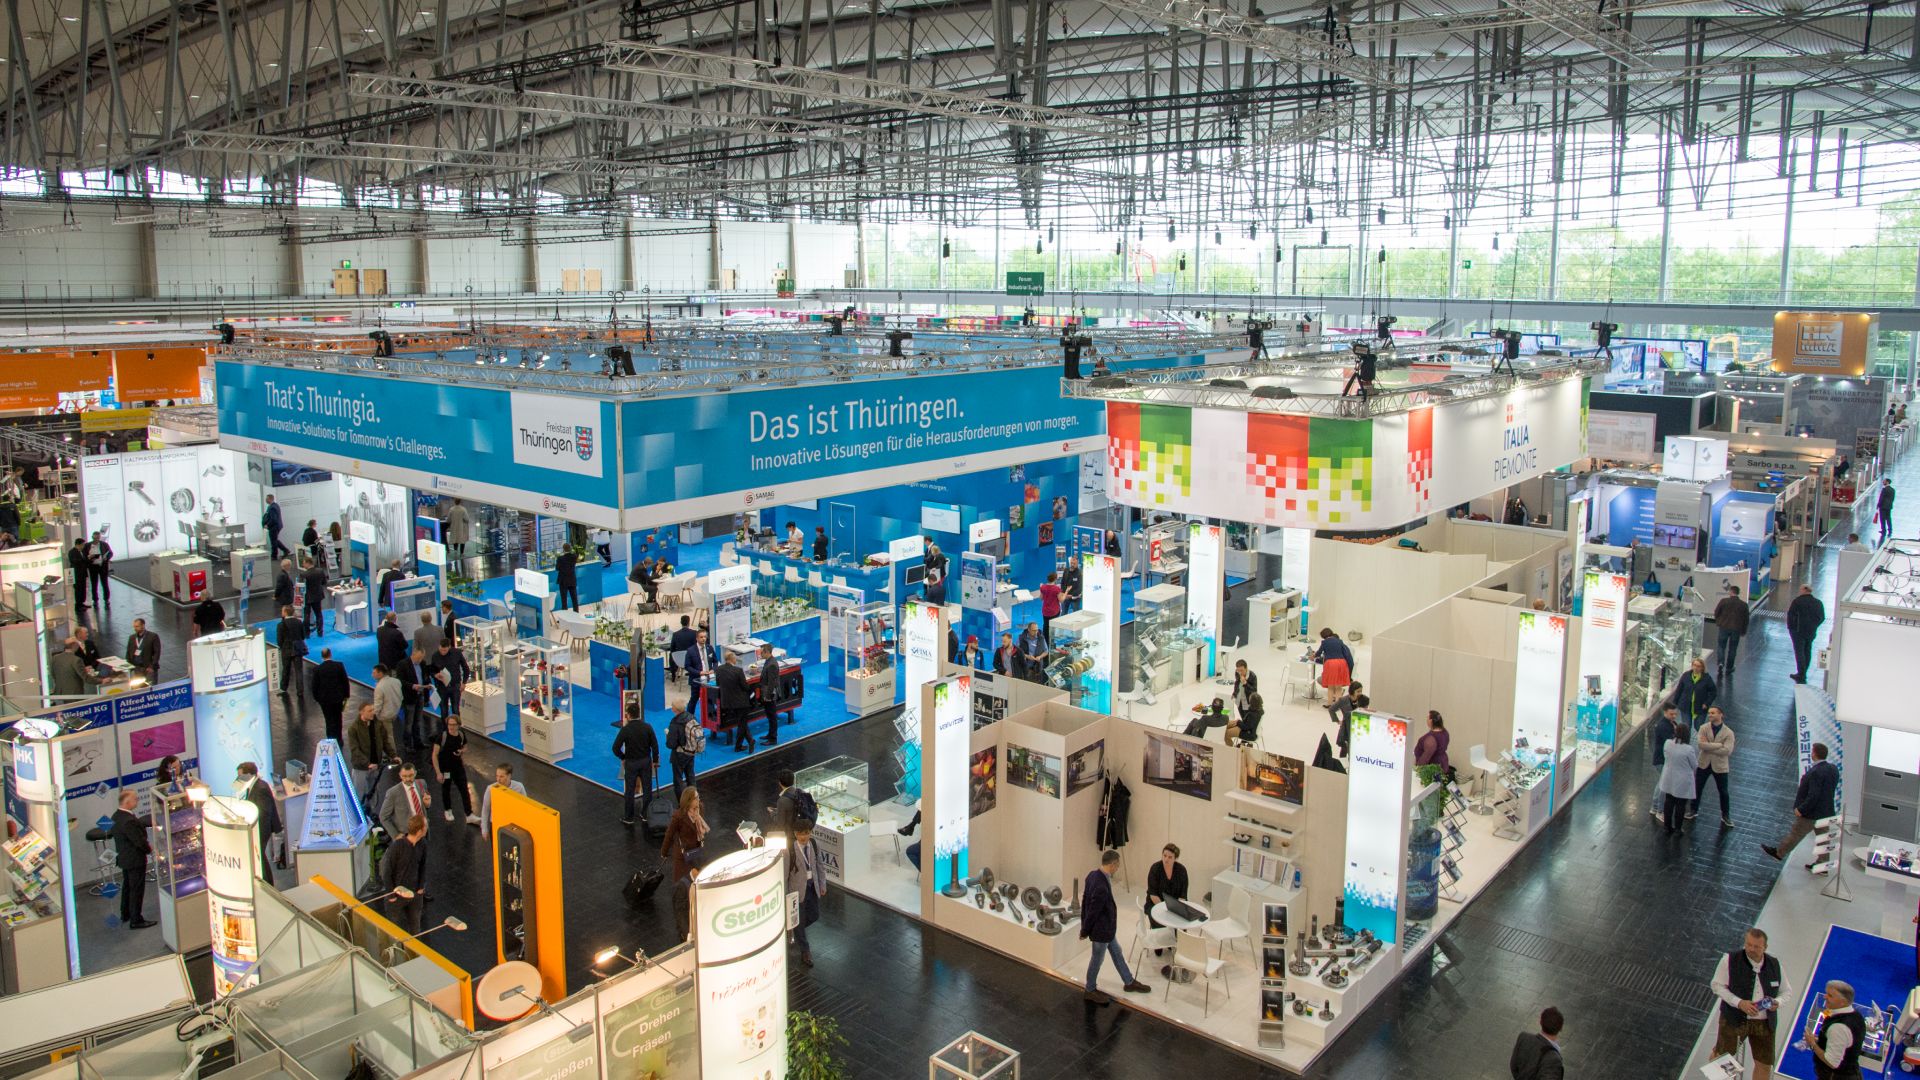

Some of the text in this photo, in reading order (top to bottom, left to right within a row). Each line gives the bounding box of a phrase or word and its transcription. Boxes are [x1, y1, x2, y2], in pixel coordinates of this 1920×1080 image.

[264, 381, 381, 426] That's Thuringia.
[546, 421, 572, 435] Freistaat
[749, 395, 965, 443] Das ist Thüringen.
[267, 416, 447, 461] Innovative Solutions for Tomorrow's Challenges.
[519, 427, 573, 454] Thüringen
[750, 415, 1080, 471] Innovative Lösungen für die Herausforderungen von morgen.
[1503, 425, 1529, 451] ITALIA
[85, 459, 118, 468] HECKLER
[1494, 448, 1537, 481] PIEMONTE
[1747, 460, 1772, 468] Sarbo
[120, 687, 188, 707] Alfred Weigel KG
[120, 701, 160, 714] Federnfabrik
[63, 704, 108, 720] Weigel KG
[1355, 755, 1395, 770] valvital
[66, 786, 96, 798] iegeteile
[206, 848, 242, 870] EMANN
[724, 891, 781, 929] Steinel
[639, 1007, 680, 1035] Drehen
[632, 1030, 672, 1059] Fräsen
